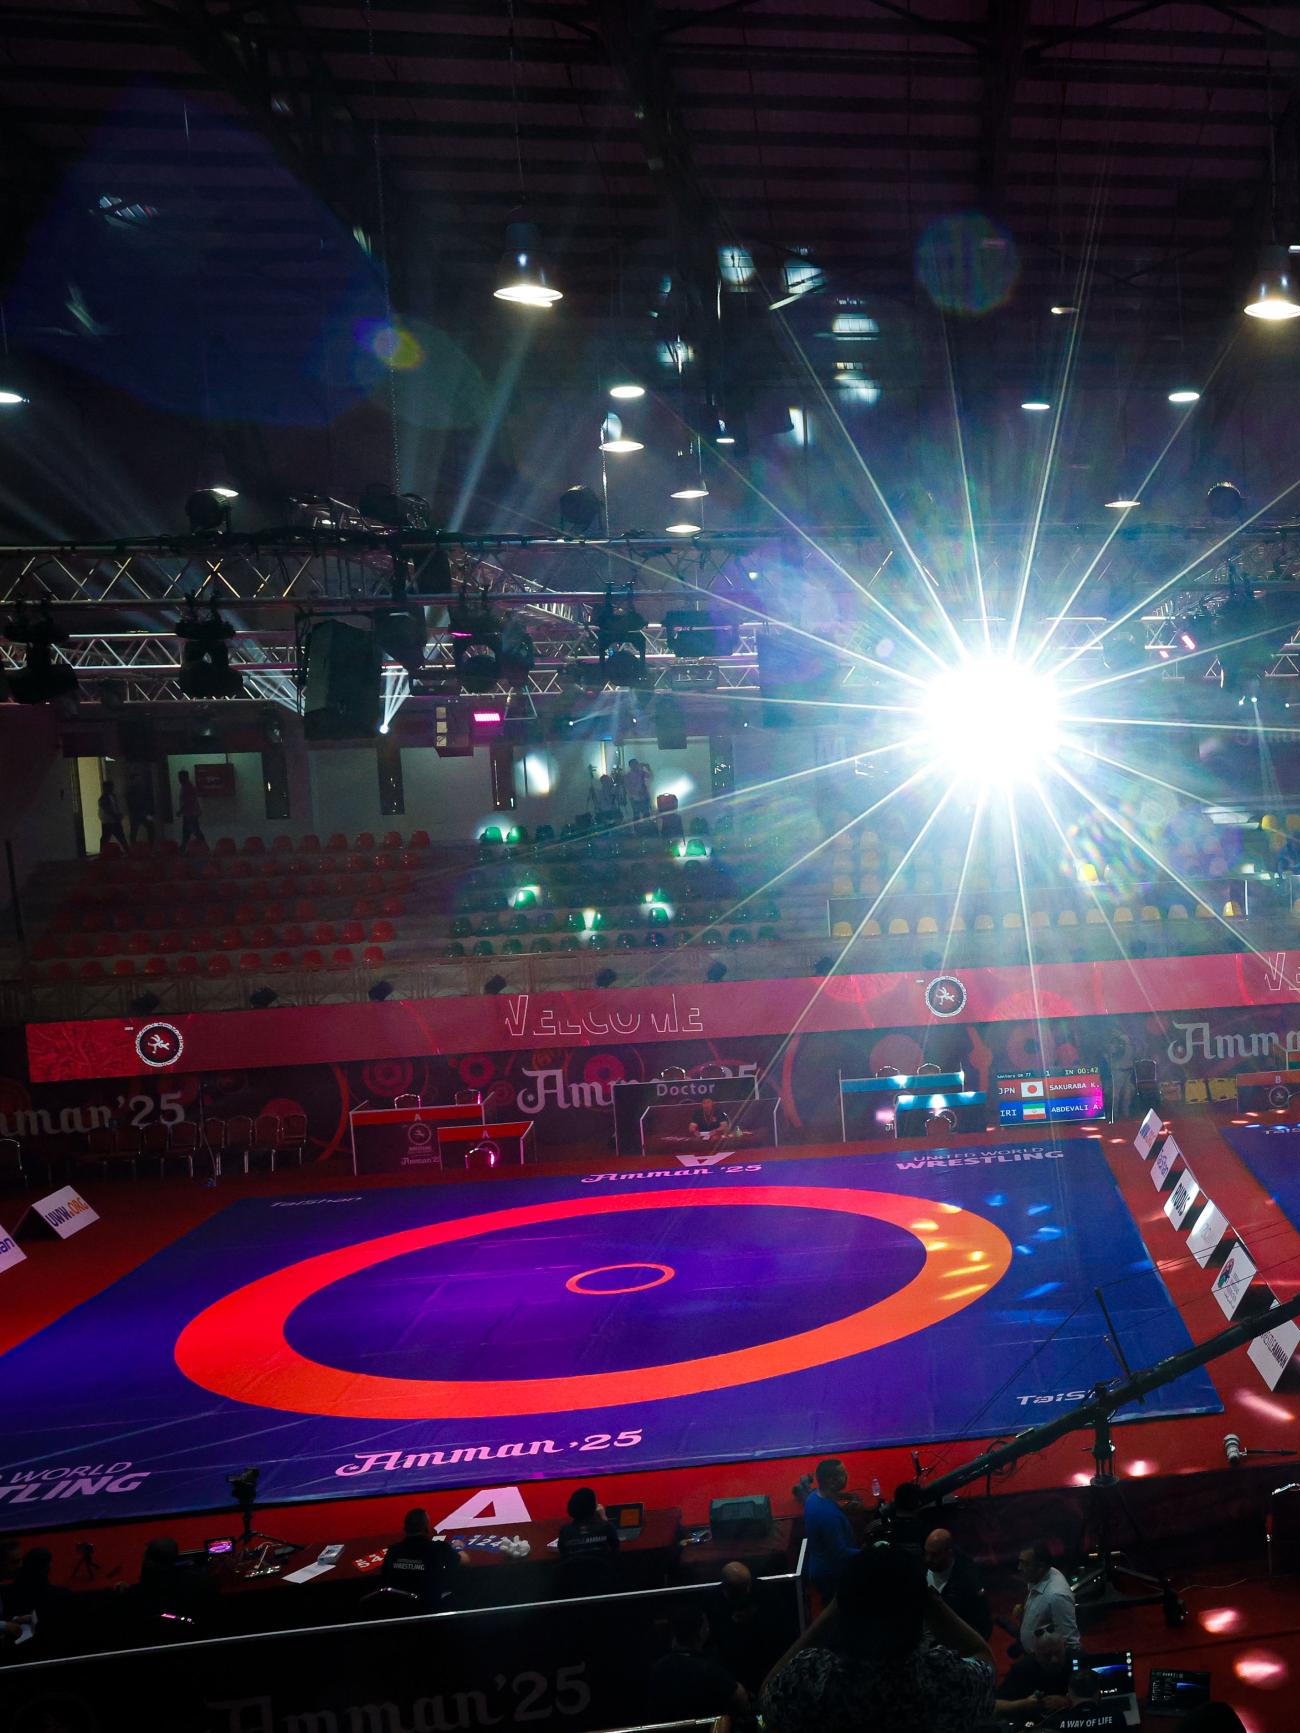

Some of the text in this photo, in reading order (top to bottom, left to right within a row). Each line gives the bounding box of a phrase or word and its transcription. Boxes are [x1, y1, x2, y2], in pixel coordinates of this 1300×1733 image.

[656, 1083, 716, 1097] Doctor
[998, 1087, 1016, 1095] JPN
[1049, 1083, 1087, 1091] SAKURABA
[1000, 1109, 1017, 1117] IRI
[1051, 1105, 1089, 1113] ABDEVALI
[896, 1150, 1064, 1170] WRESTLING
[913, 1147, 1044, 1162] UNITED WORLD
[1016, 1389, 1096, 1406] TaiS
[10, 1461, 133, 1484] WORLD
[433, 1486, 532, 1533] A
[1060, 1716, 1113, 1728] A WAY OF LIFE
